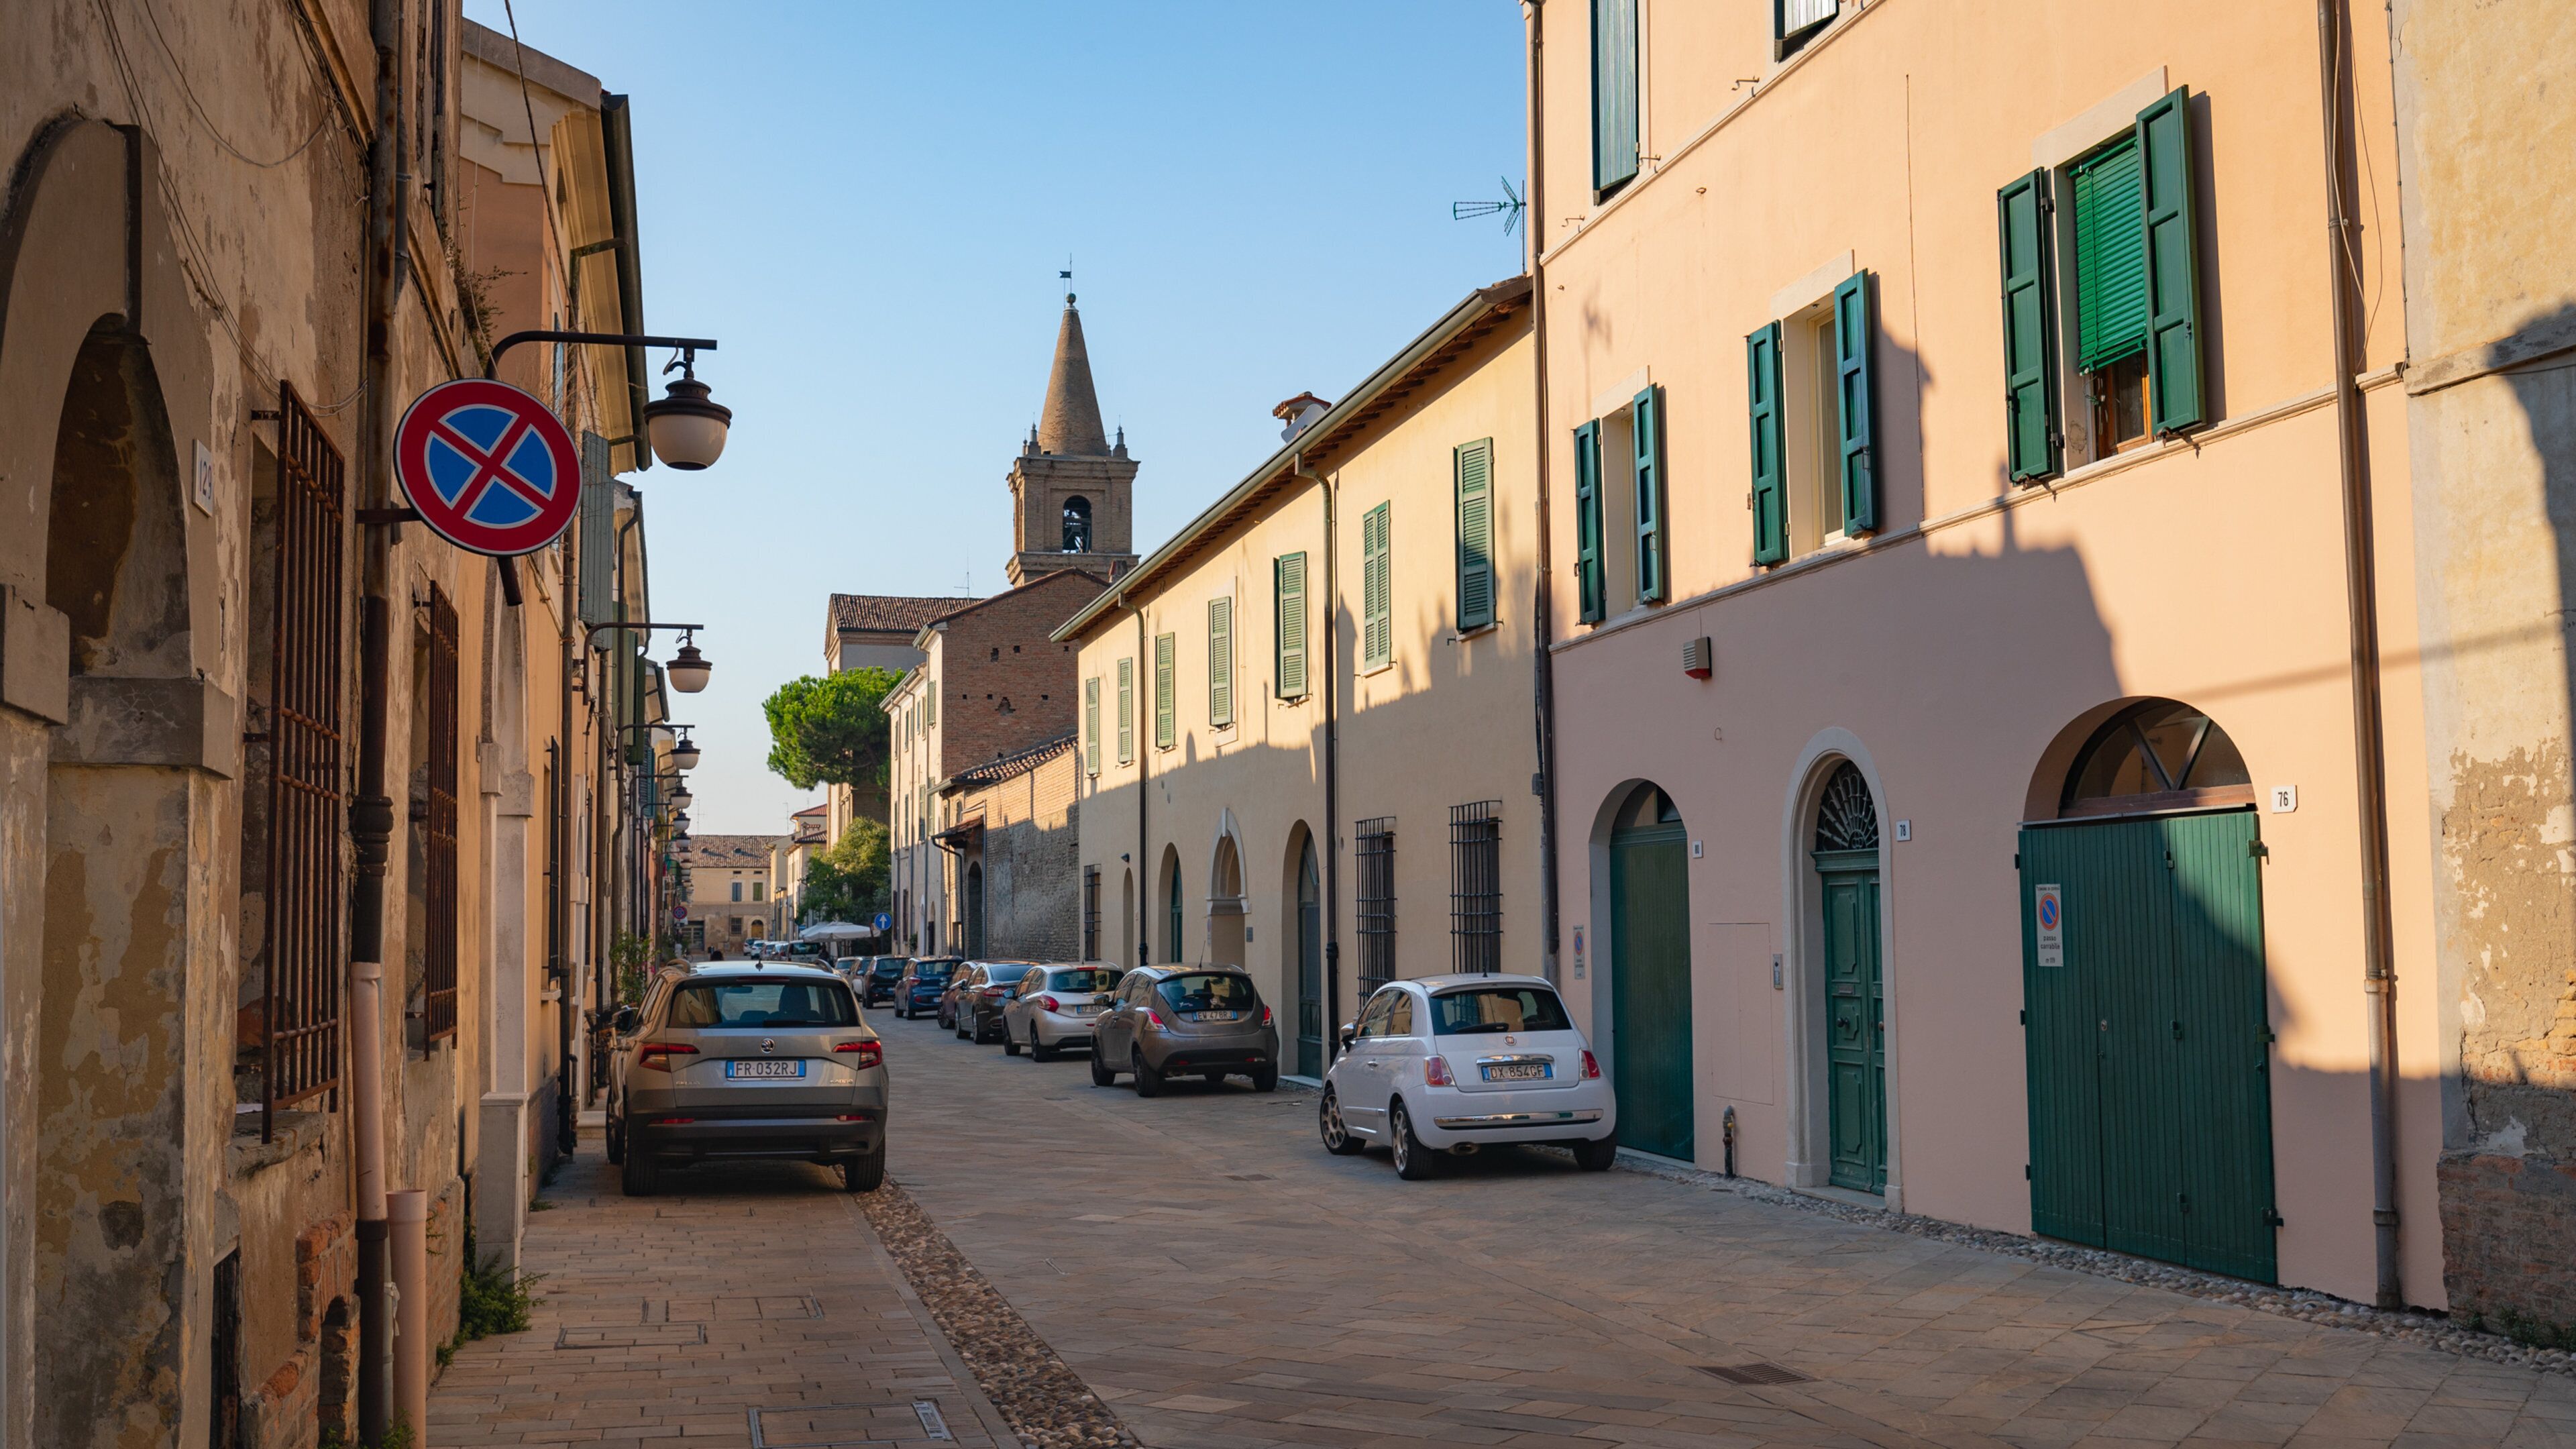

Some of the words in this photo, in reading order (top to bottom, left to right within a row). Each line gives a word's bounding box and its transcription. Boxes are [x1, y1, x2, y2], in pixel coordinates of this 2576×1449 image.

[199, 458, 212, 500] 129
[2277, 791, 2288, 807] 76
[736, 1062, 751, 1075] FR
[756, 1062, 797, 1075] 032RJ
[1490, 1067, 1505, 1078] DX
[1509, 1065, 1543, 1077] 854GF
